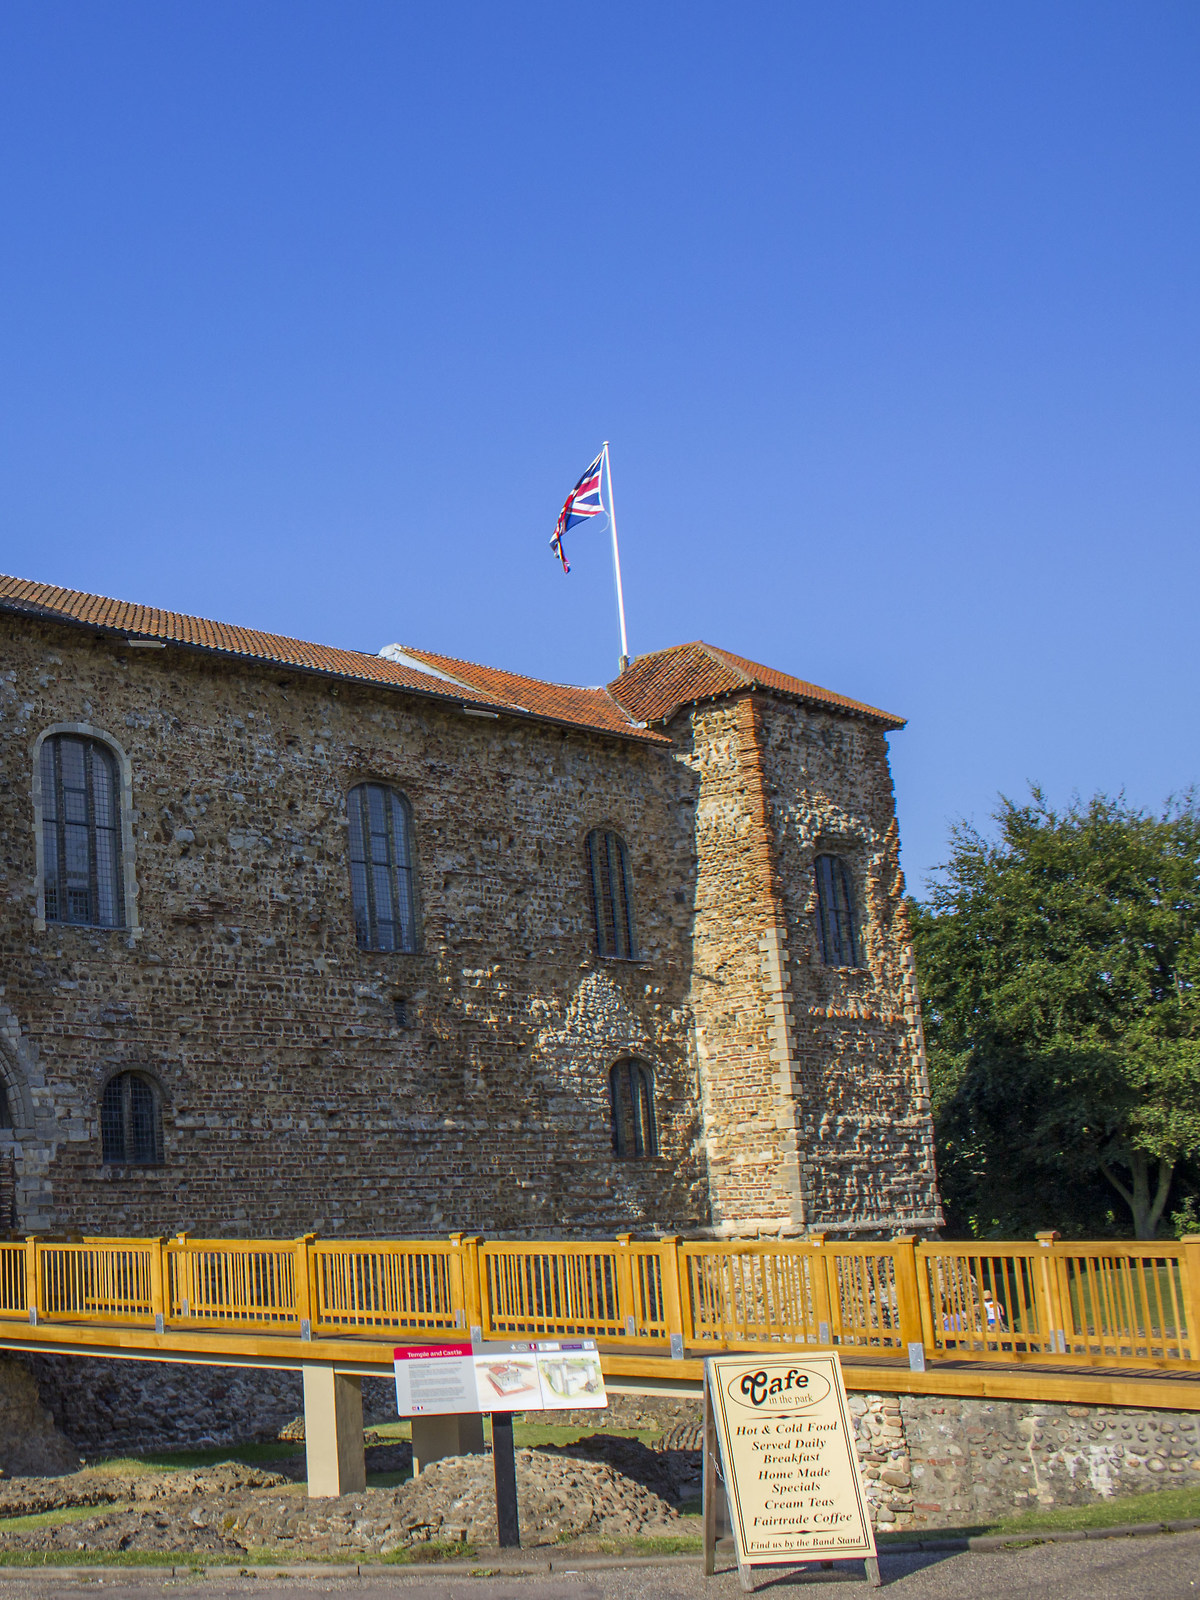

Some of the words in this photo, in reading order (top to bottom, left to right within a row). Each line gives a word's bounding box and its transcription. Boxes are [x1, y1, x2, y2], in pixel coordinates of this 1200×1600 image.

[407, 1351, 429, 1359] Temple
[741, 1370, 808, 1405] Cafe
[769, 1395, 777, 1403] in
[780, 1394, 792, 1403] the
[795, 1393, 813, 1404] park
[737, 1426, 757, 1435] Hot
[762, 1424, 771, 1434] &
[776, 1423, 802, 1434] Cold
[808, 1421, 837, 1432] Food
[752, 1440, 791, 1451] Served
[795, 1438, 826, 1450] Daily
[764, 1453, 820, 1464] Breakfast
[759, 1470, 793, 1480] Home
[798, 1468, 830, 1478] Made
[772, 1482, 821, 1495] Specials
[765, 1499, 803, 1509] Cream
[808, 1498, 834, 1507] Teas
[753, 1515, 809, 1526] Fairtrade
[814, 1513, 852, 1524] Coffee
[751, 1541, 771, 1549] Find
[785, 1539, 794, 1549] by
[797, 1538, 809, 1546] the
[837, 1536, 861, 1544] Stand
